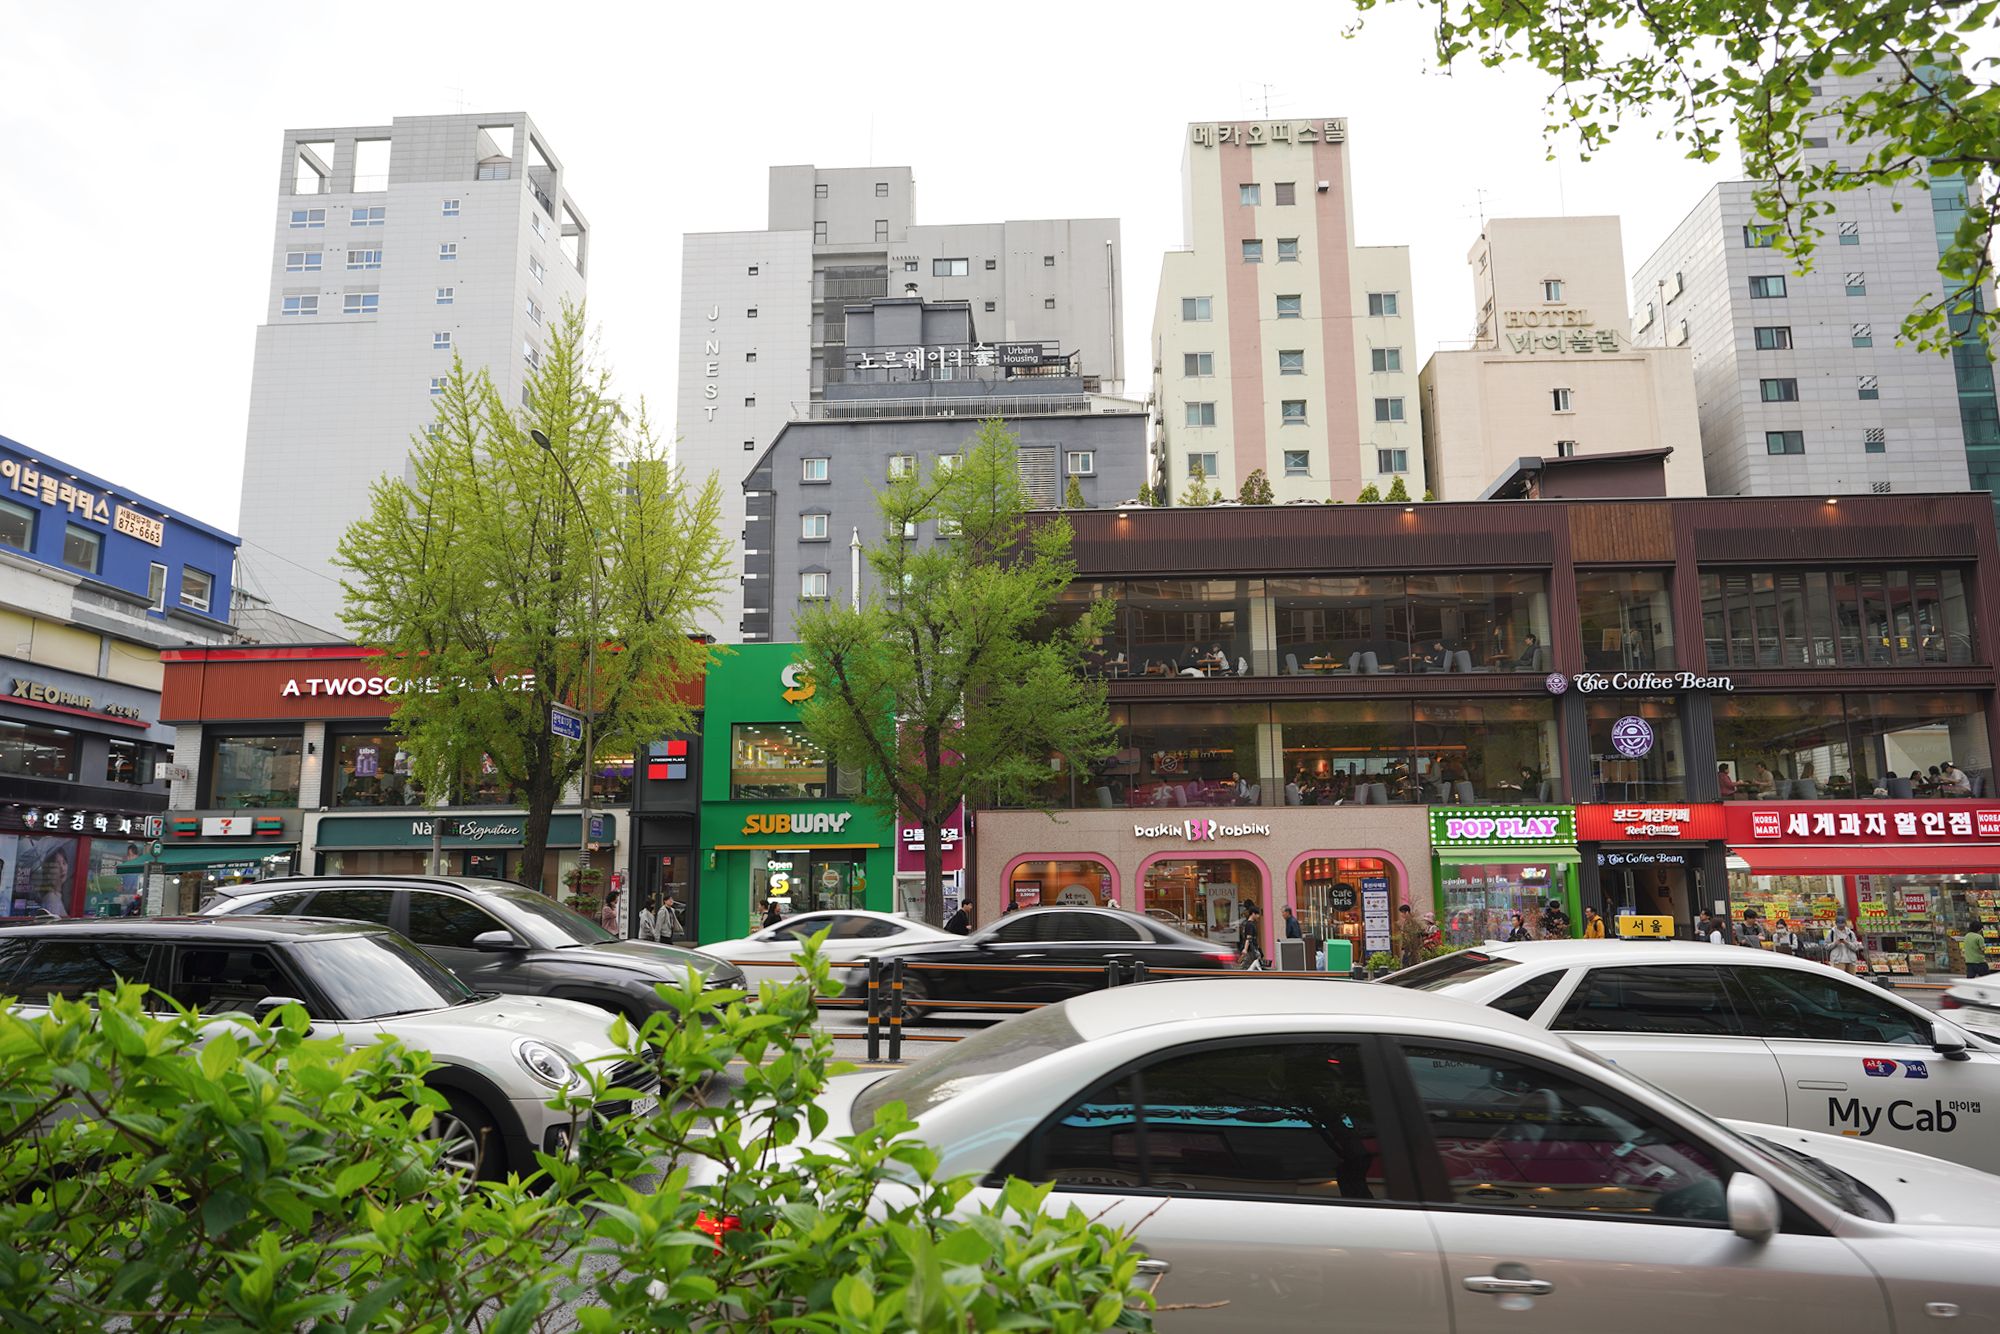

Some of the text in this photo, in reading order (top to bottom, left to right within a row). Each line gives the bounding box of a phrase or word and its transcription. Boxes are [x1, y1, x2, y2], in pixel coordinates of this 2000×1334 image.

[1192, 120, 1346, 148] 메카오피스텔
[1504, 309, 1595, 329] HOTEL
[1505, 329, 1620, 354] 바이올린
[856, 341, 996, 372] 노르웨이의 숲
[1003, 353, 1039, 365] Housing
[1007, 346, 1035, 356] Urban
[0, 459, 110, 525] 이브필라테스
[118, 518, 161, 543] 875-6663
[282, 679, 300, 696] A
[305, 675, 440, 697] TWOSOME
[1572, 673, 1609, 693] The
[1612, 672, 1673, 690] Coffee
[1674, 672, 1735, 691] Bean
[1611, 807, 1690, 822] 보드게임카페
[1754, 815, 1778, 825] KOREA
[43, 812, 132, 834] 안경박사
[463, 820, 520, 840] Signature
[741, 811, 852, 836] SUBWAY
[1133, 822, 1183, 839] baskin
[1219, 823, 1271, 837] robbins
[1447, 817, 1559, 838] POP PLAY
[1625, 824, 1681, 837] Red Button
[1755, 825, 1779, 835] MART
[1786, 811, 1972, 836] 세계과자 할인점
[767, 860, 793, 871] Open
[1607, 853, 1685, 865] The Coffee Bean
[1208, 888, 1236, 897] DUBAI
[1332, 889, 1353, 898] Cafe
[1905, 895, 1924, 903] KOREA
[1333, 898, 1352, 906] Bris
[1906, 903, 1926, 911] MART
[1866, 1060, 1885, 1072] 서울
[1949, 1100, 1981, 1113] 마이캡
[1828, 1097, 1957, 1137] My Cab
